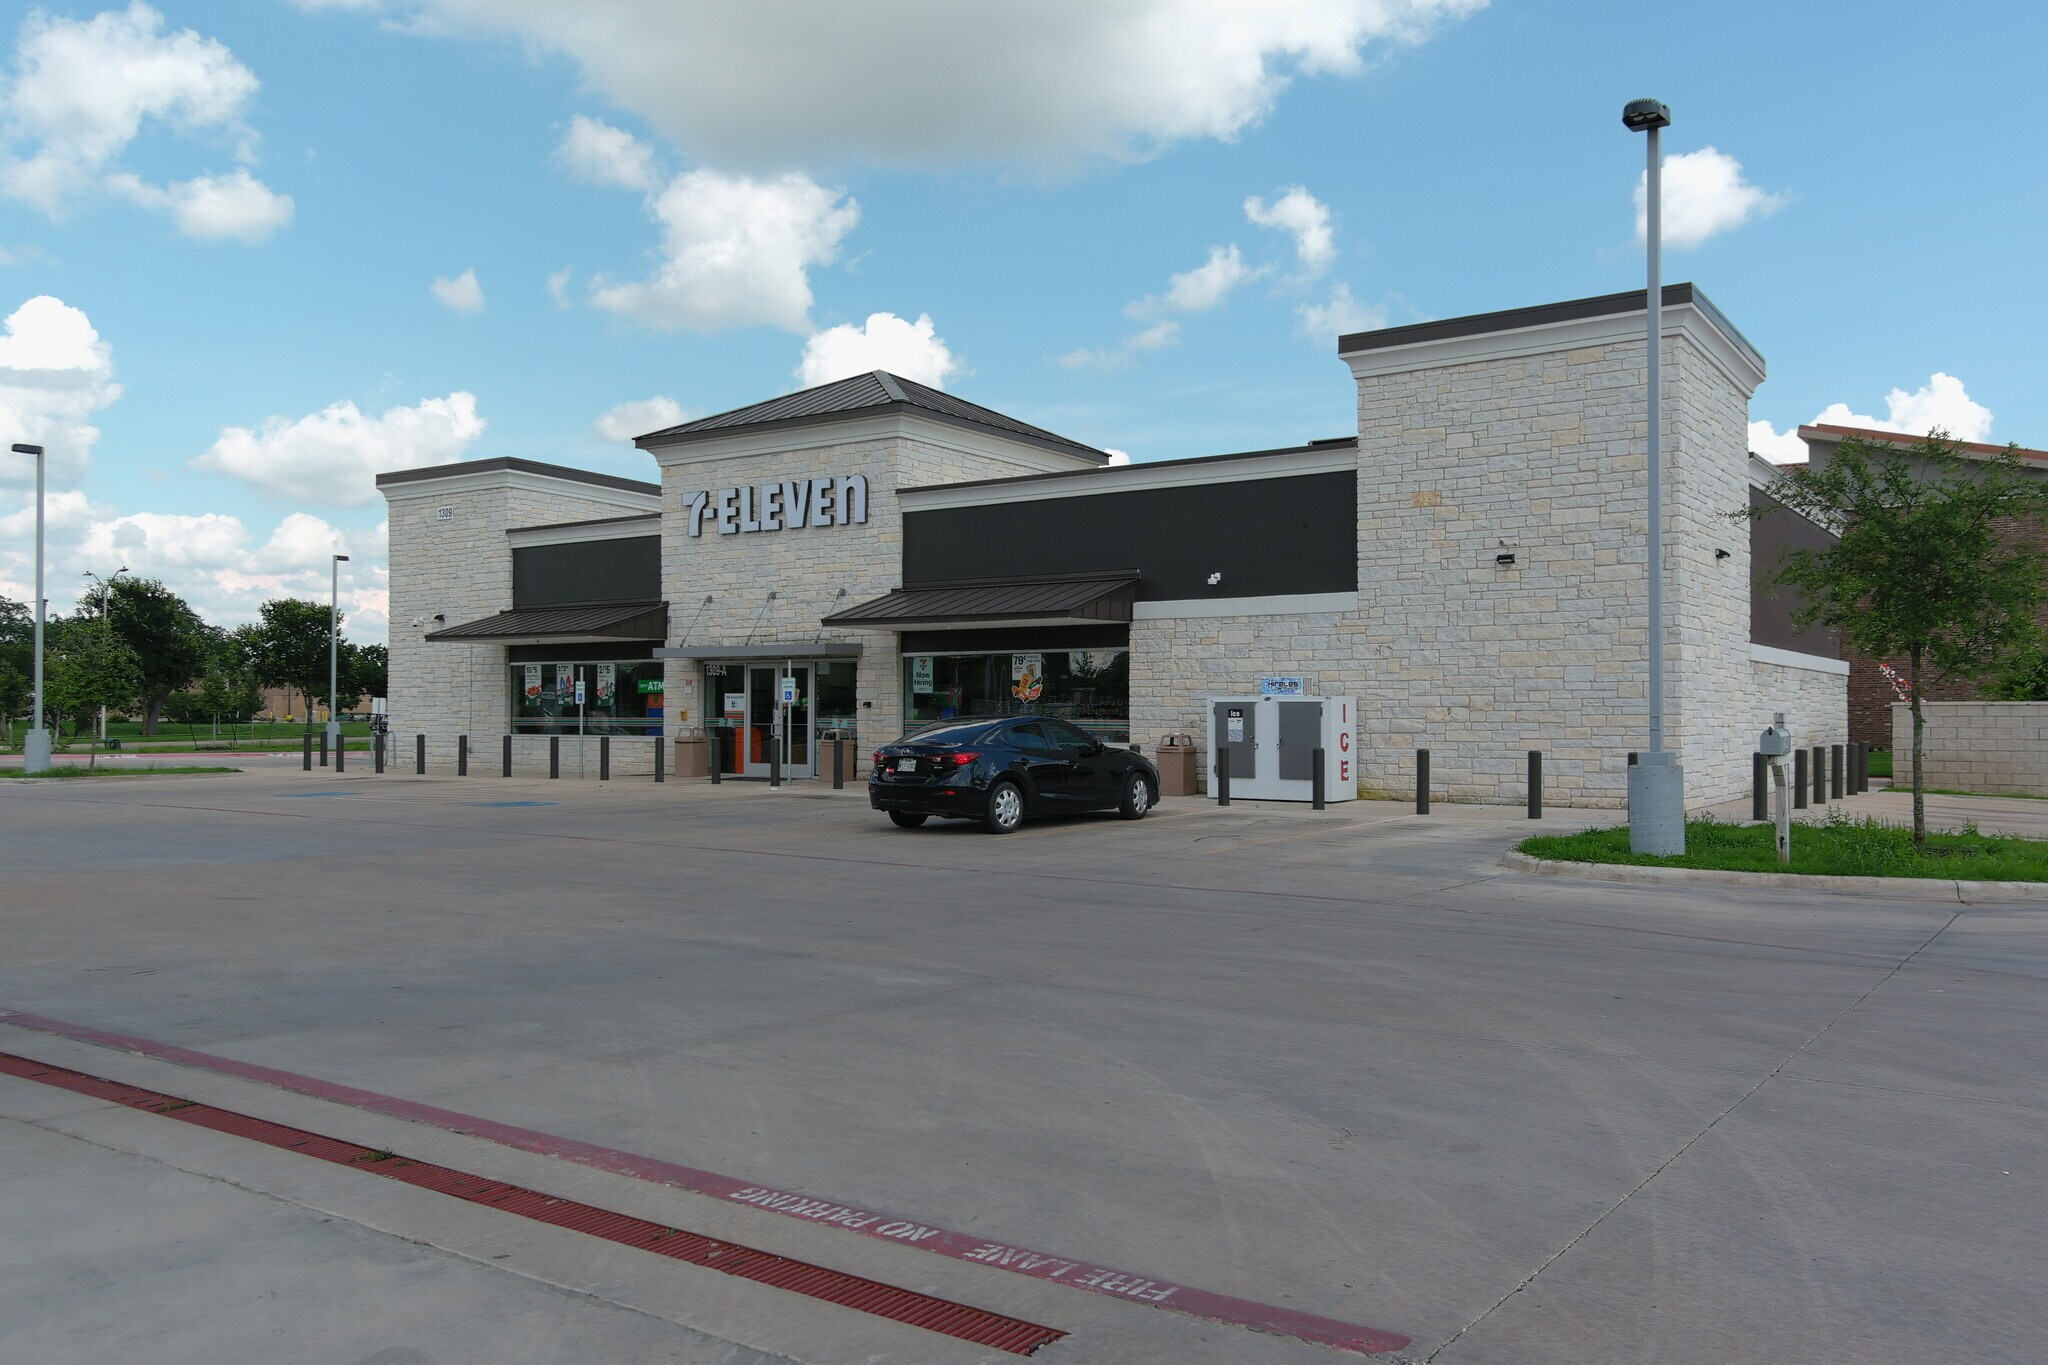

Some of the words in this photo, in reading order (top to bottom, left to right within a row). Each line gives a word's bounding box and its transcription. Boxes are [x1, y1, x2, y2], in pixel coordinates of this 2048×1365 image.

[438, 507, 453, 518] 1309
[705, 665, 727, 676] 1309-A
[647, 681, 664, 691] ATM
[914, 679, 932, 688] Hiring
[727, 1187, 881, 1229] PARKING
[876, 1220, 940, 1242] NO
[963, 1243, 1080, 1277] LANE
[1074, 1268, 1180, 1302] FIRE
